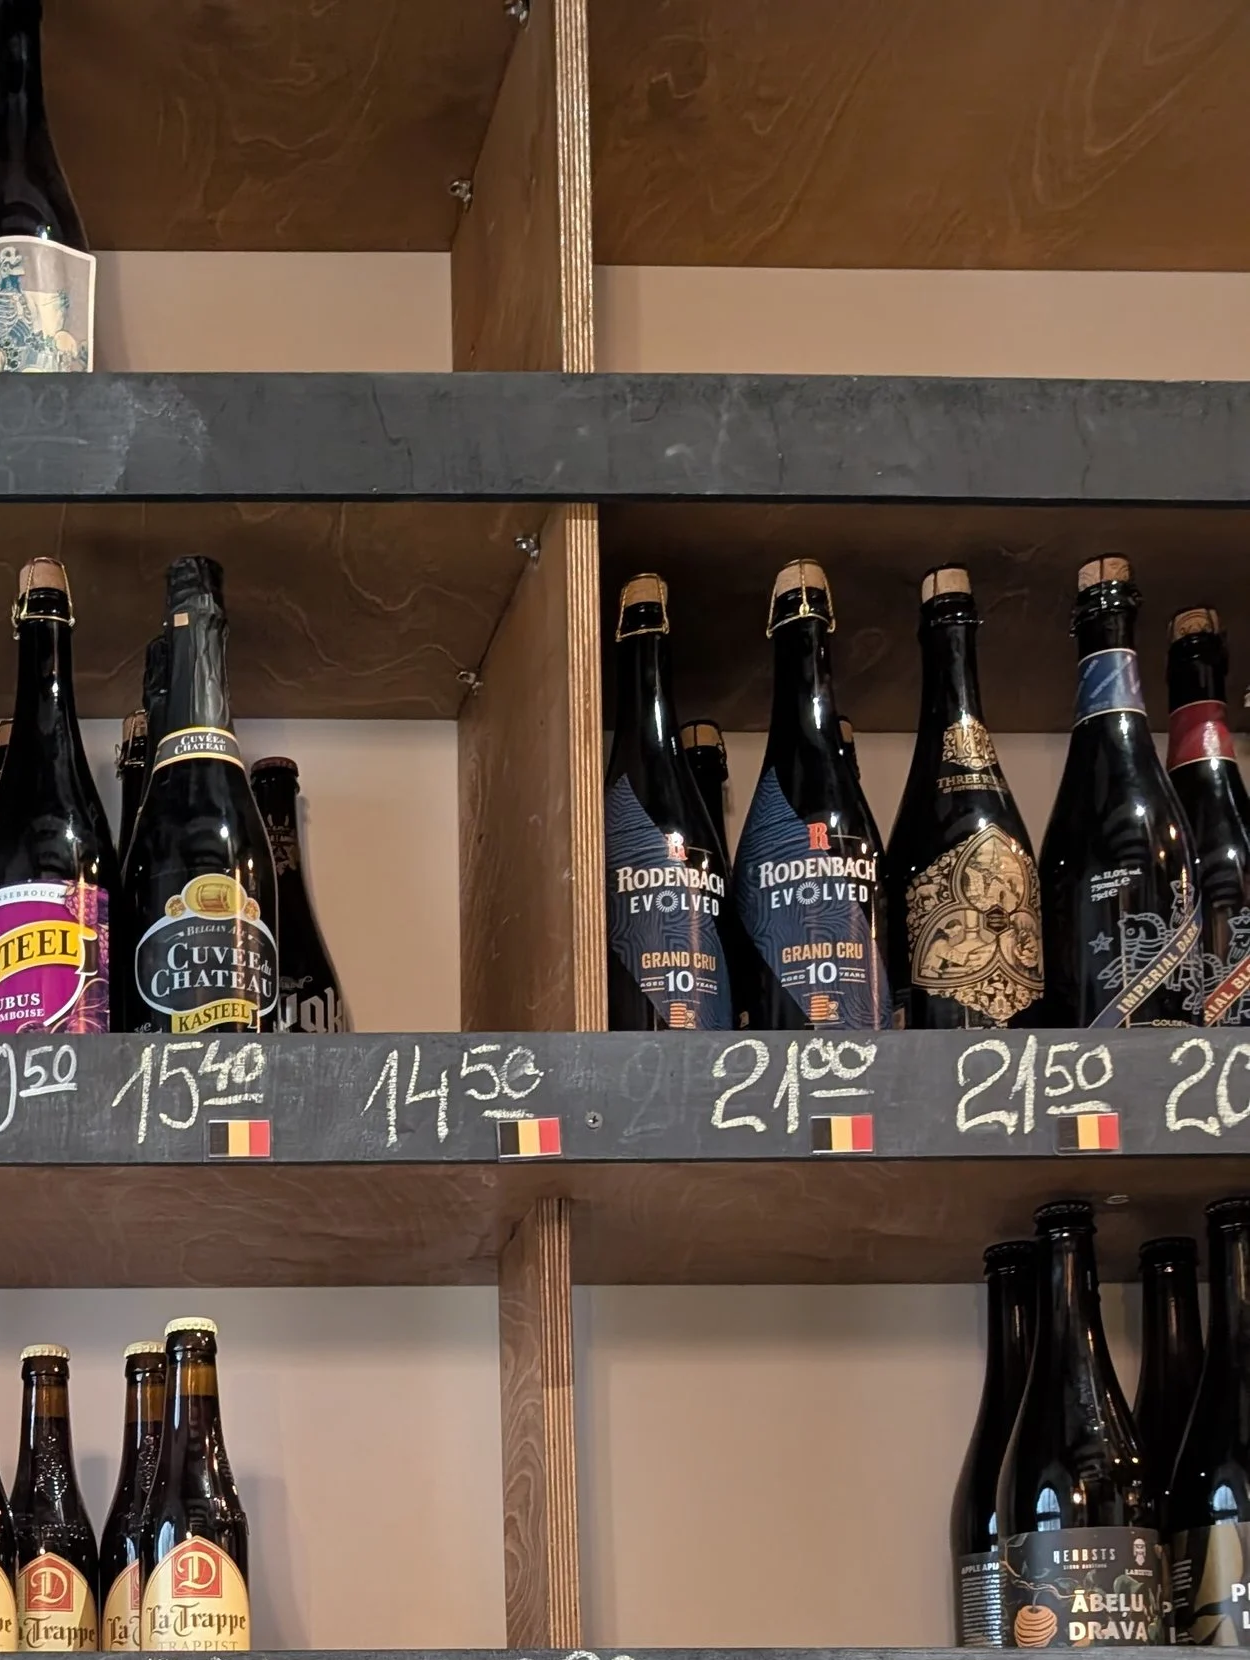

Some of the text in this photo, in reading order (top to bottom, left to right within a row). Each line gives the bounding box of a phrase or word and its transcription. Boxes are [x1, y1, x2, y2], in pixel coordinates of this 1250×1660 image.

[616, 866, 725, 898] RODENBACH
[758, 856, 877, 890] RODENBACH
[641, 951, 717, 972] GRAND CRU
[781, 941, 864, 964] GRAND CRU
[150, 968, 273, 999] CHATEAU
[665, 970, 694, 993] 10
[806, 962, 837, 985] 10
[1115, 952, 1179, 1014] IMPERIAL
[178, 1002, 251, 1033] KASTEEL
[1070, 1588, 1145, 1618] ĀBEĻU
[25, 1615, 97, 1649] Trappe
[106, 1616, 131, 1649] La
[146, 1602, 248, 1639] La Trappe
[1068, 1619, 1149, 1642] DRAVA
